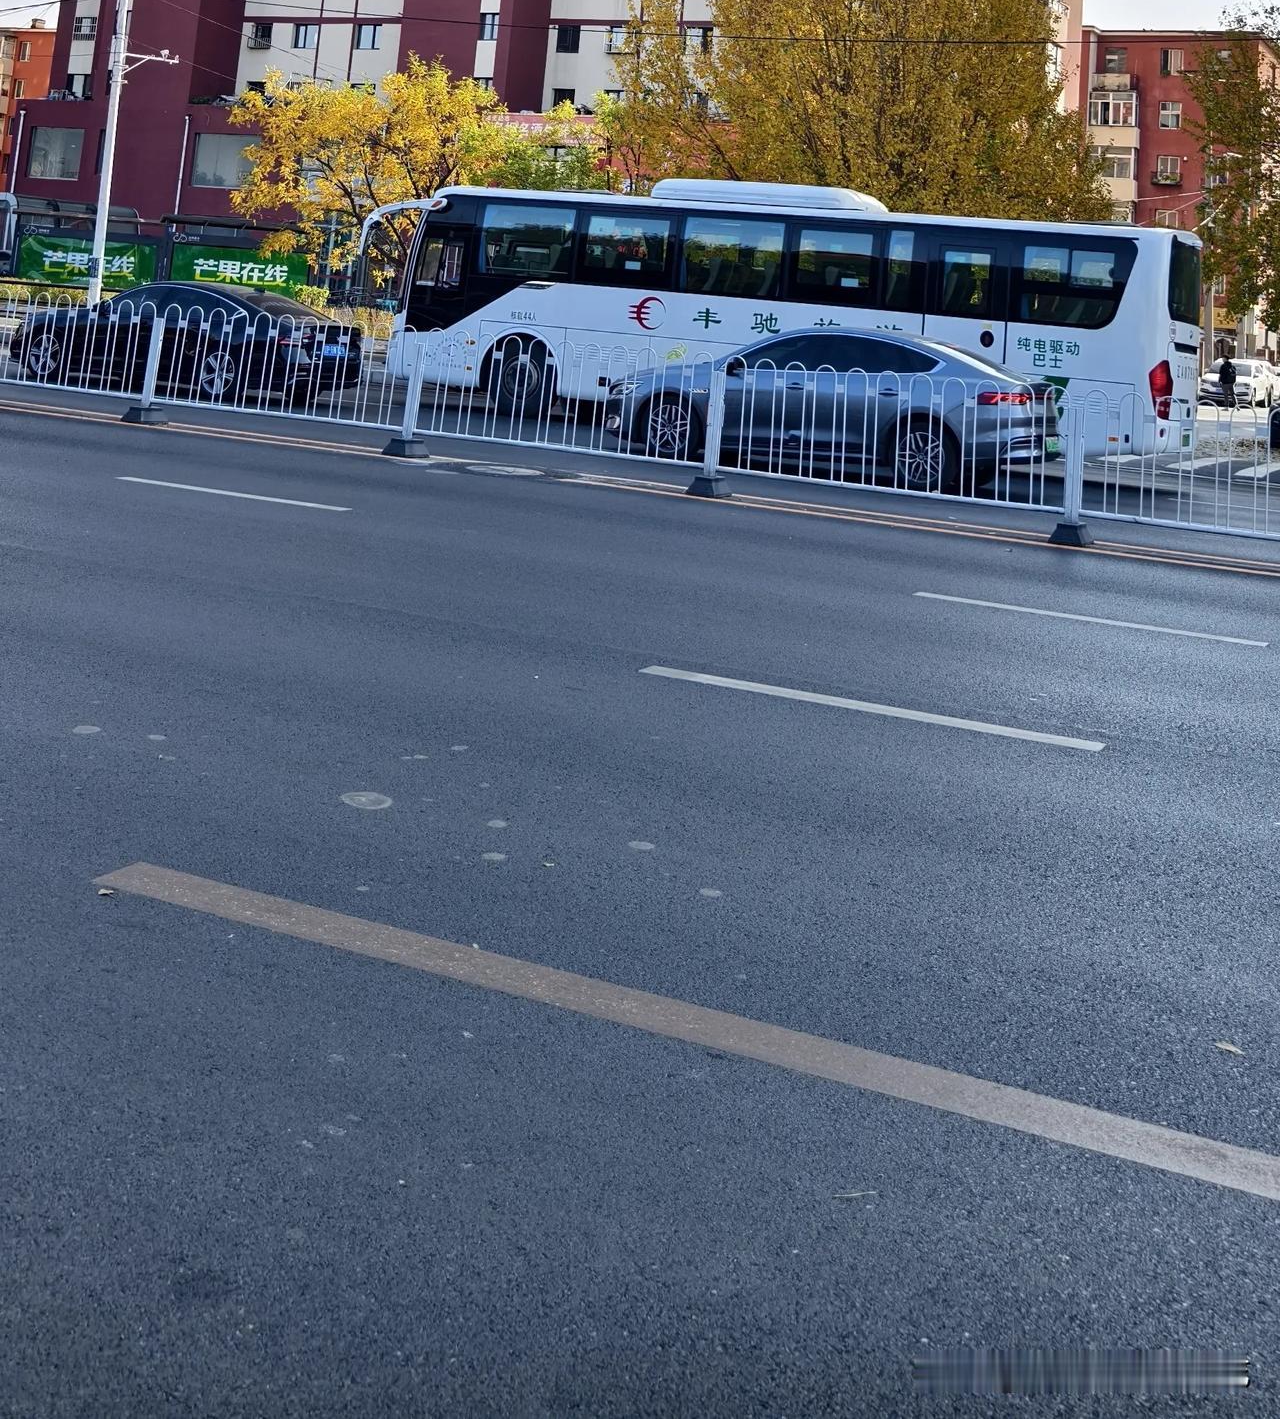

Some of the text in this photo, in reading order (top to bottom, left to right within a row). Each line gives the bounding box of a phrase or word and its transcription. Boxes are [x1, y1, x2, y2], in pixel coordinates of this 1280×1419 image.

[193, 258, 288, 286] 芒果在线
[1017, 337, 1080, 356] 纯电驱动
[1033, 353, 1063, 368] 巴士
